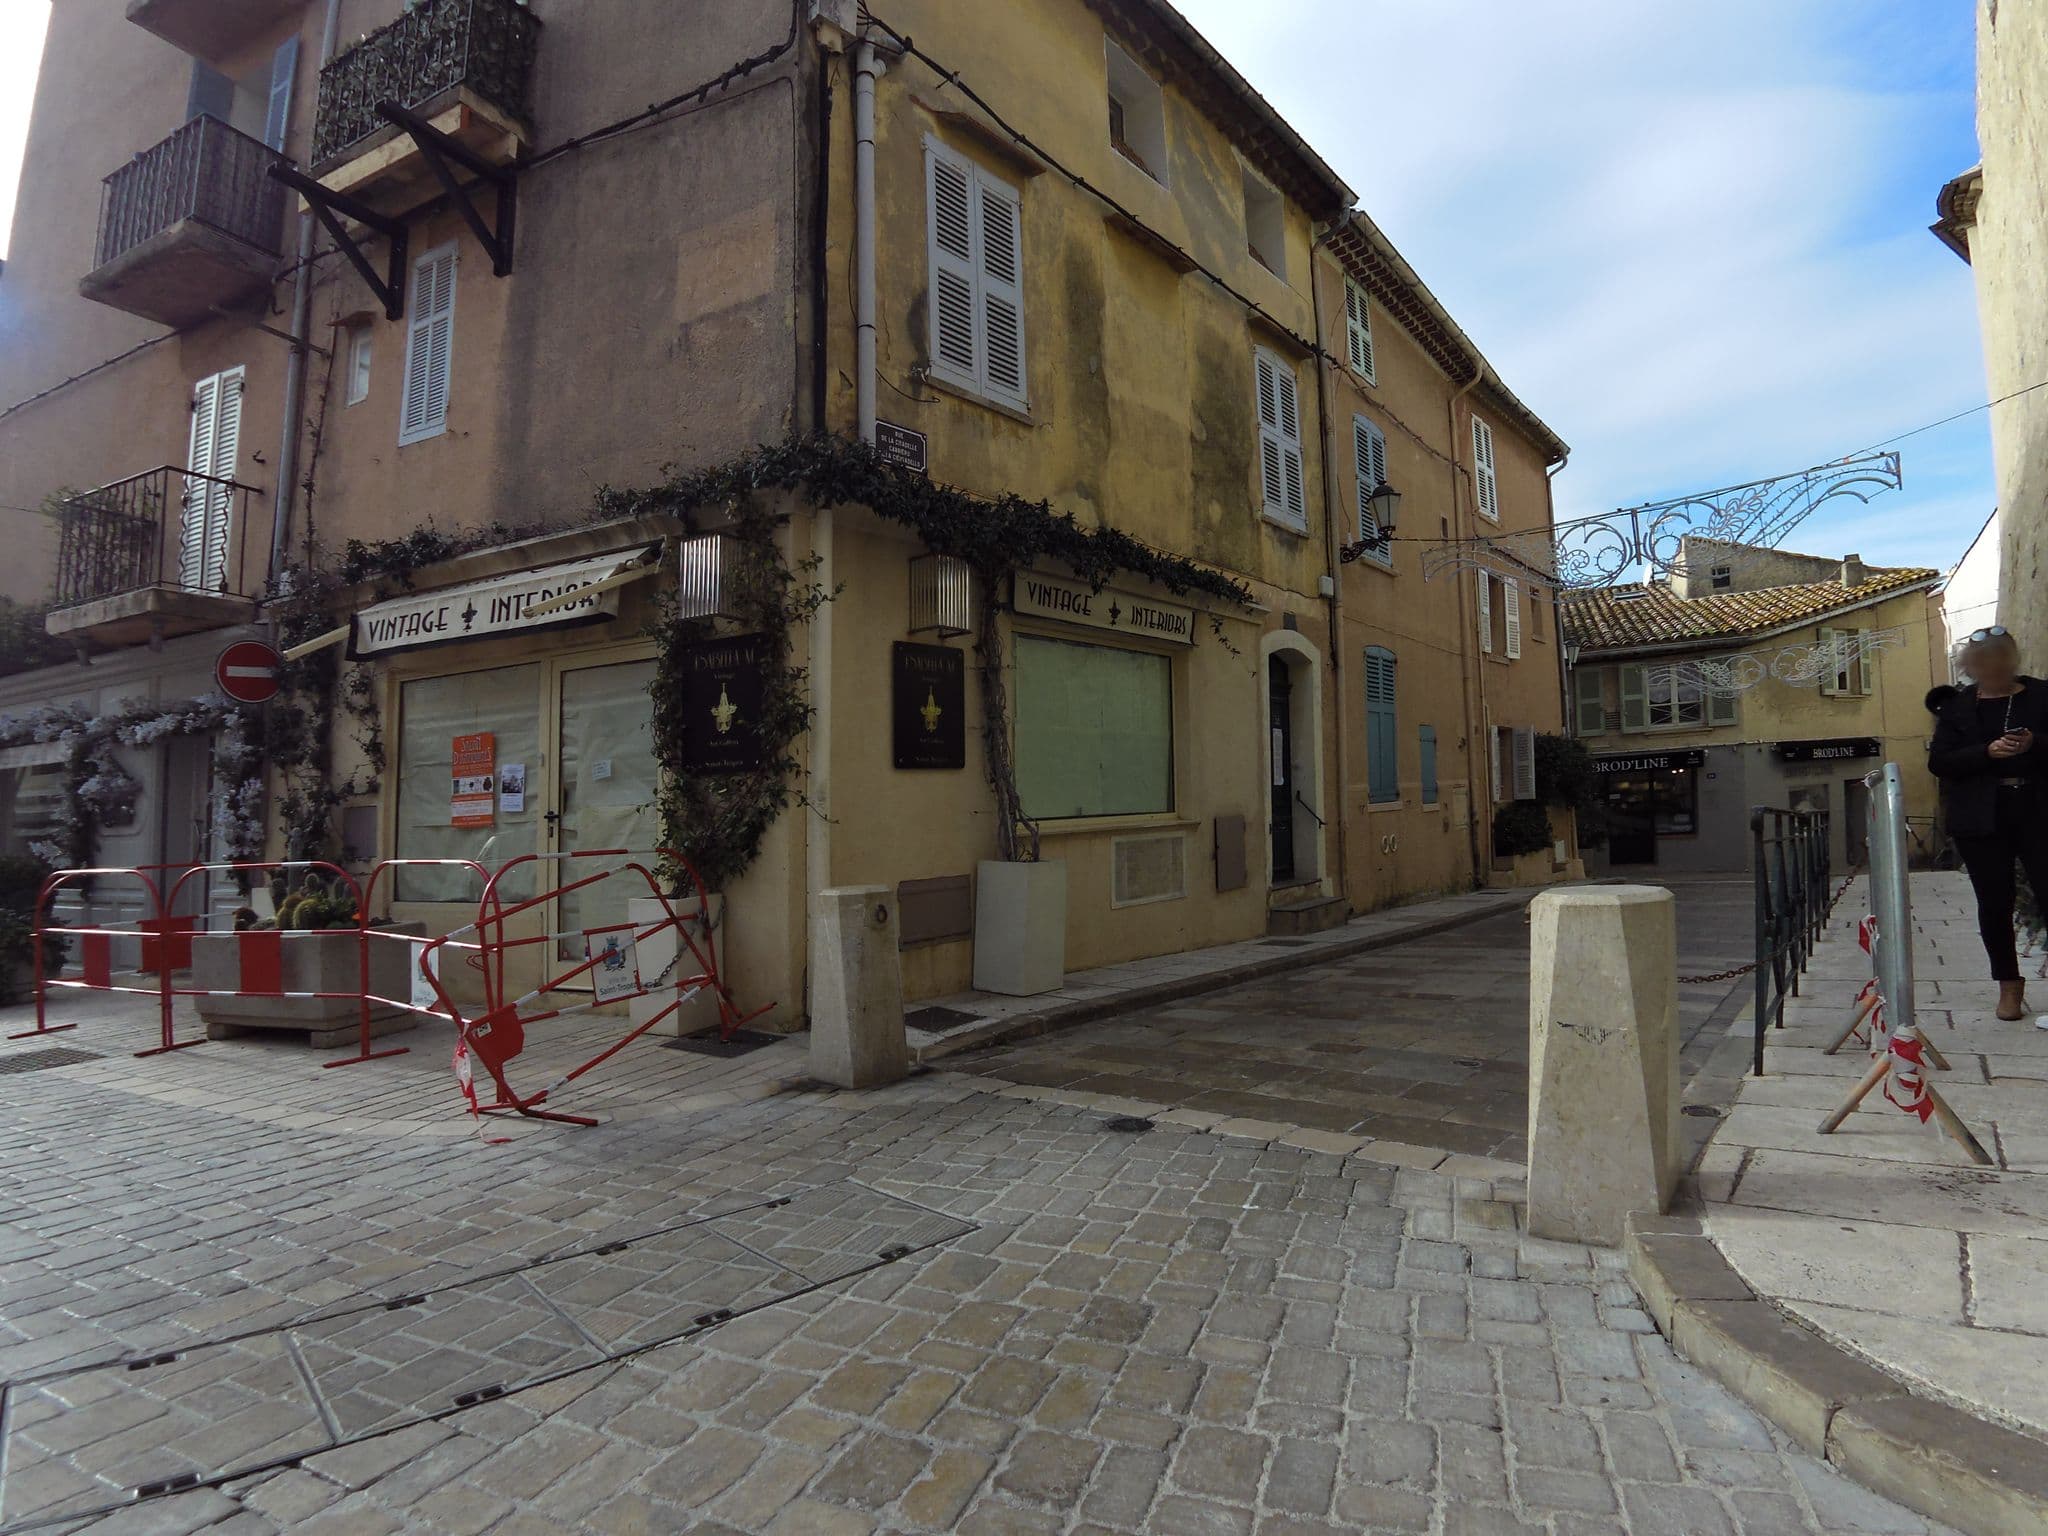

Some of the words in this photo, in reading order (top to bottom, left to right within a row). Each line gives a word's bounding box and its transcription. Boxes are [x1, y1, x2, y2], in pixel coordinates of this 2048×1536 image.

[368, 606, 450, 644] VINTAGE
[1027, 581, 1094, 617] VINTAGE
[1130, 605, 1187, 635] INTERIORS
